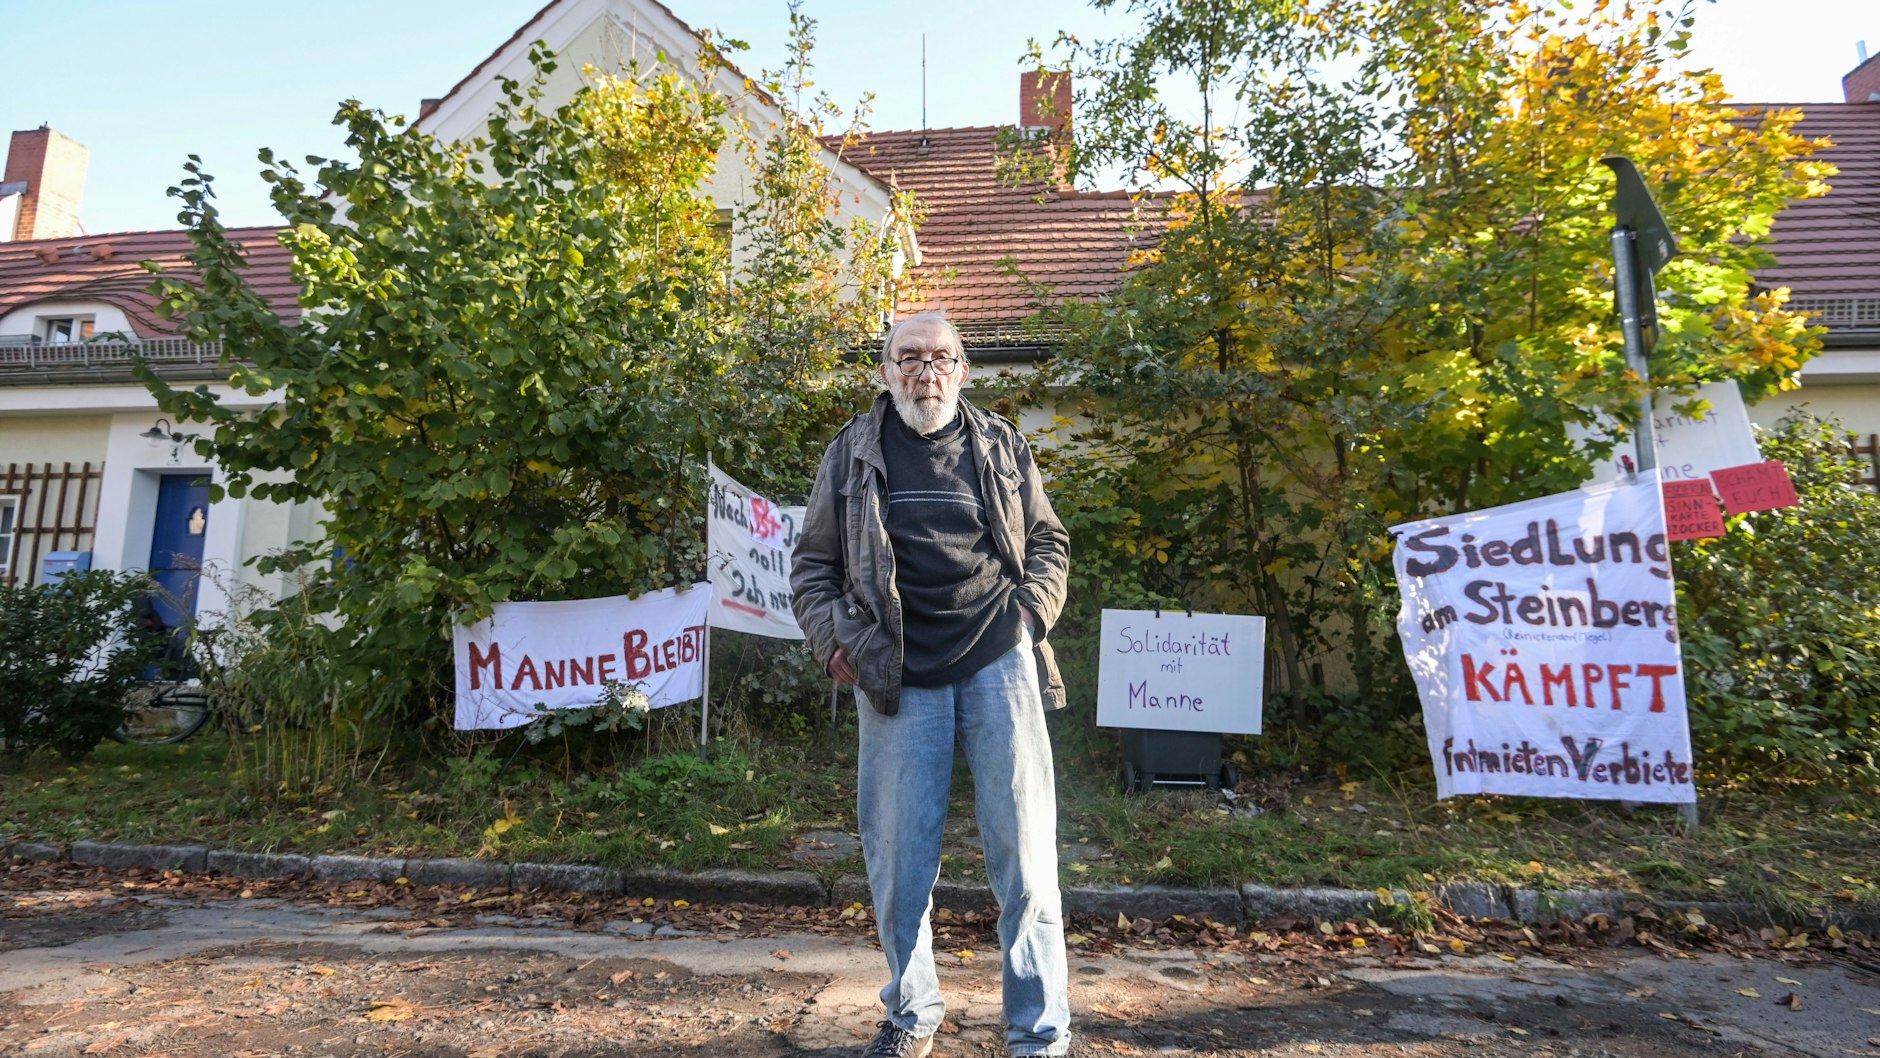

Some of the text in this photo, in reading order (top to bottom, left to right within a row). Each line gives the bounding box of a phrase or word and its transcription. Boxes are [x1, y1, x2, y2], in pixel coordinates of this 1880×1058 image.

[1667, 520, 1721, 535] ZOCKER
[1670, 511, 1710, 522] KARTE
[1421, 577, 1679, 644] am Steinberg
[468, 624, 706, 691] MANNE BLEIBT
[1160, 657, 1183, 674] mit
[1129, 680, 1204, 712] Manne
[1460, 648, 1678, 713] KÄMPFT
